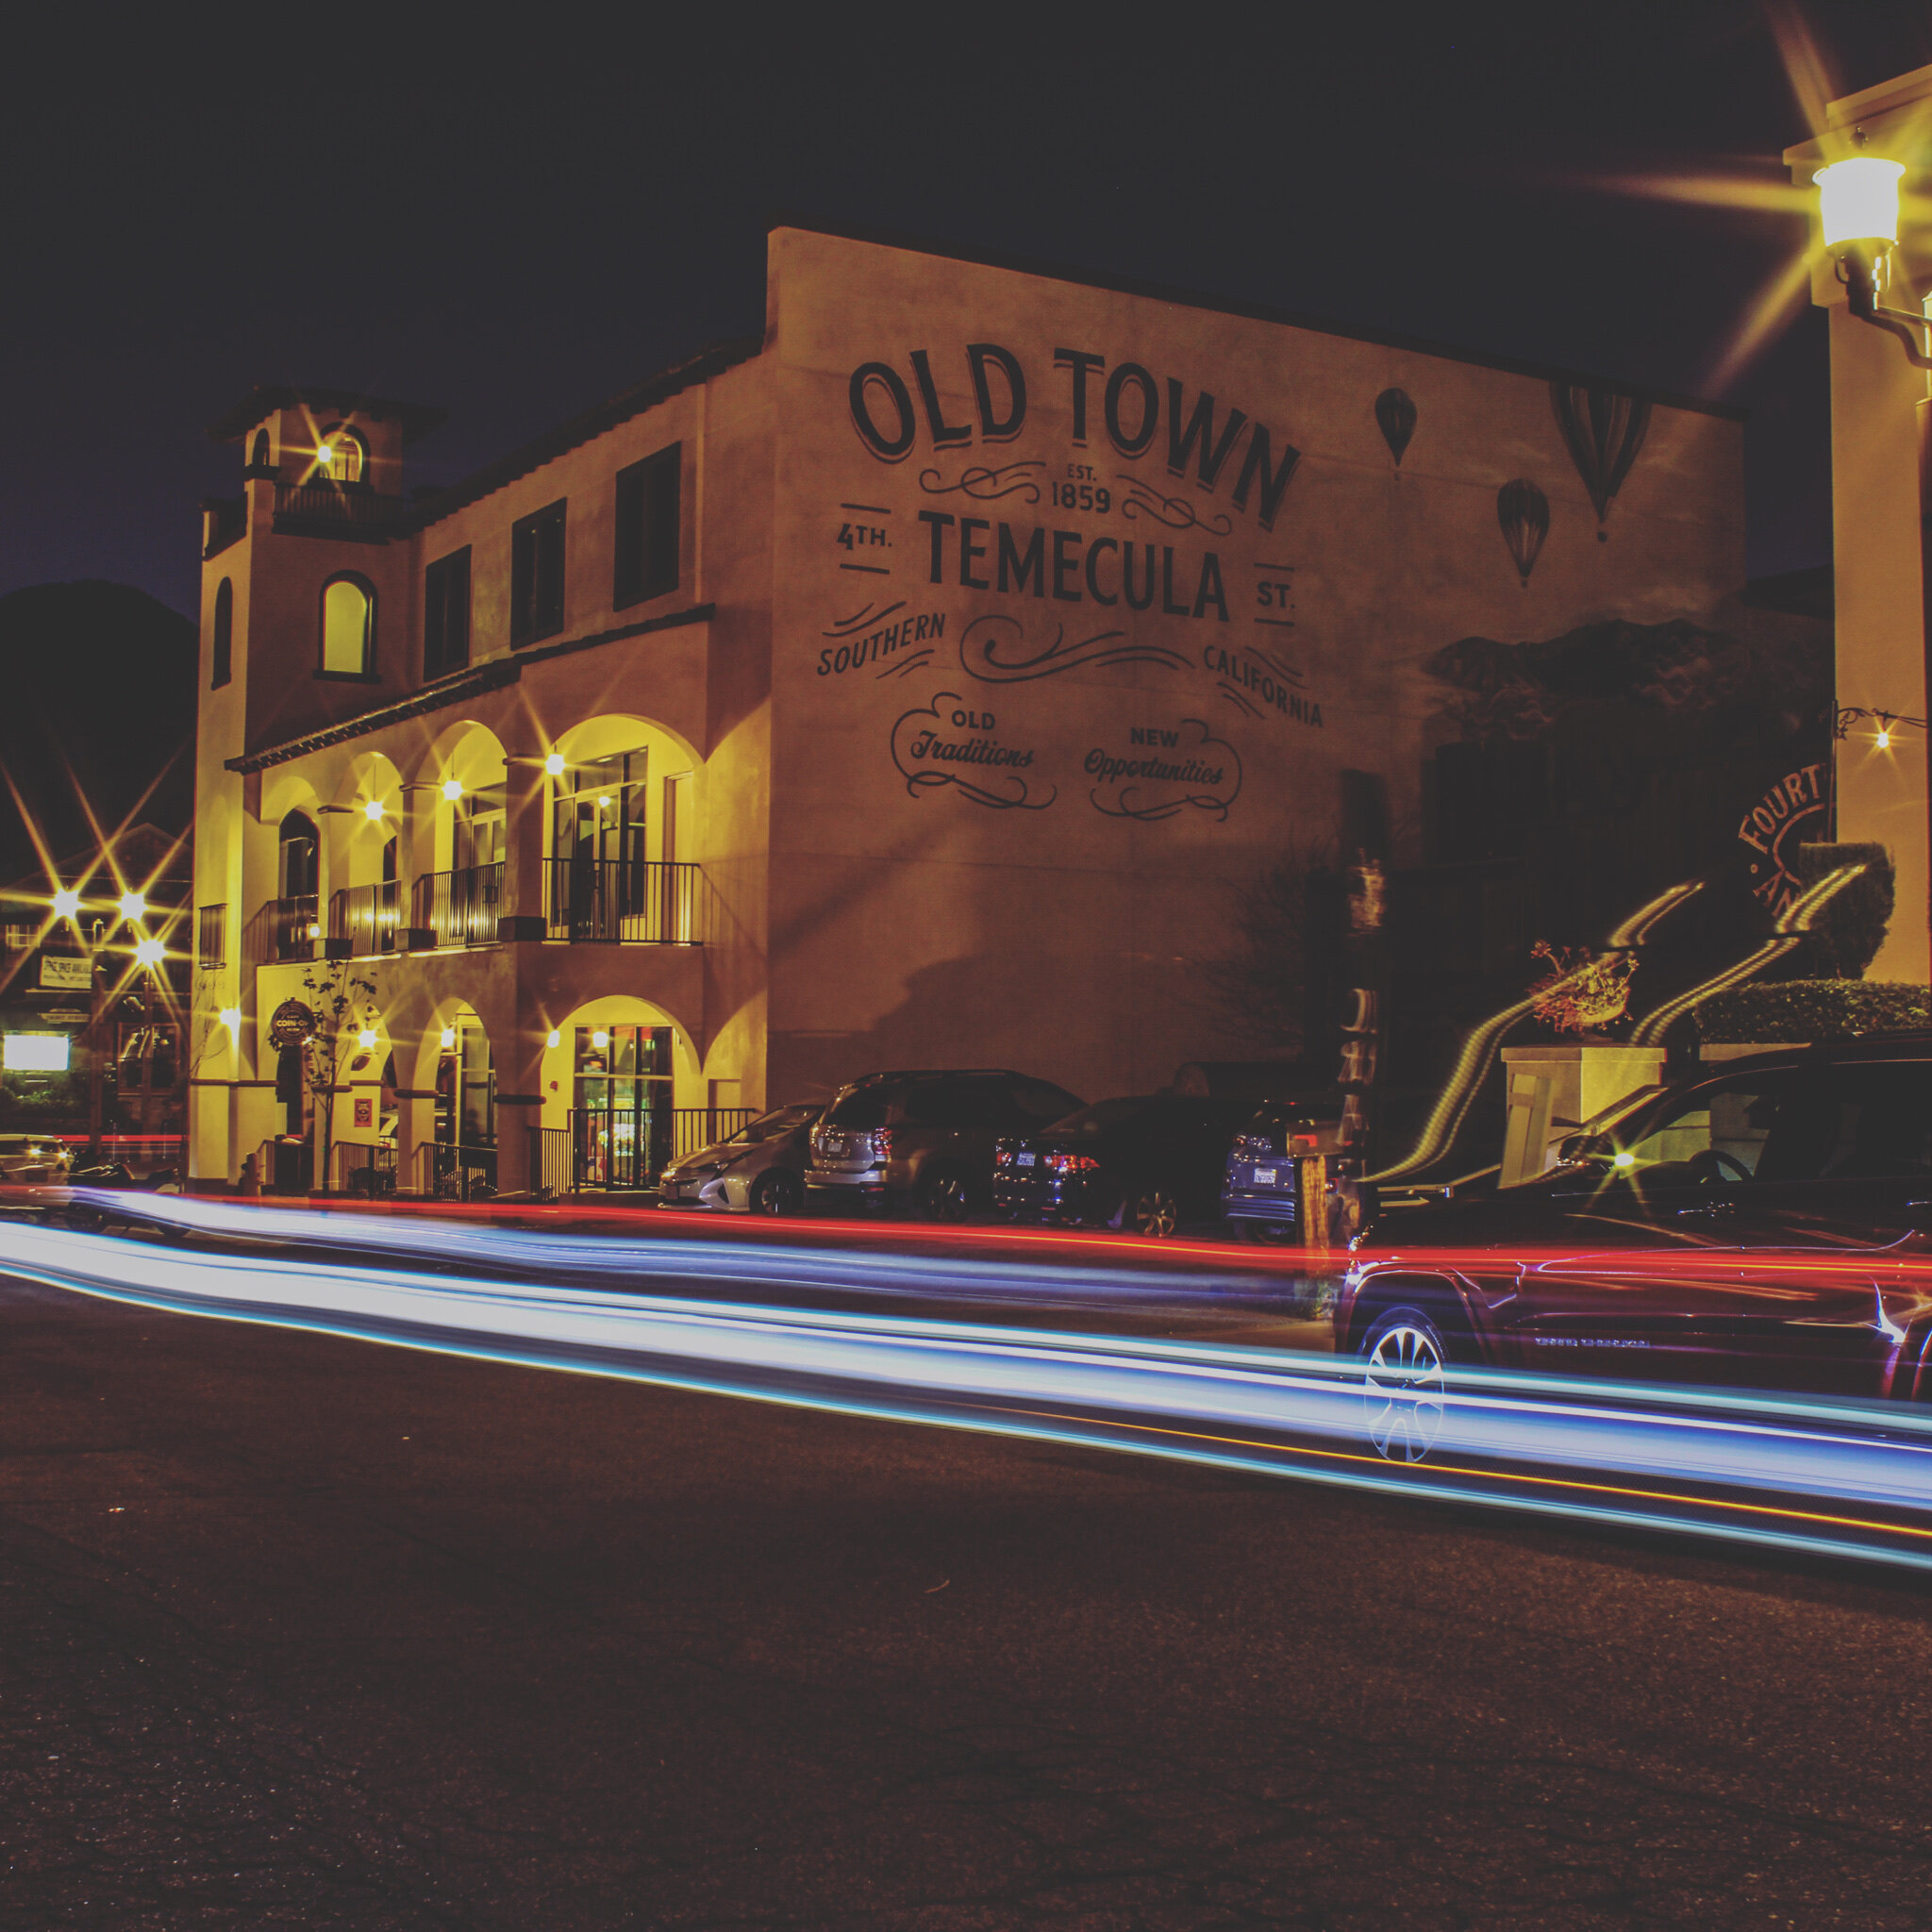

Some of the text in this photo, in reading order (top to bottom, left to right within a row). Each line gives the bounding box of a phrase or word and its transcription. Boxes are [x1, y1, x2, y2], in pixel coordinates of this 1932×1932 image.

[849, 343, 1301, 532] OLD TOWN
[1067, 463, 1096, 481] EST.
[1052, 481, 1110, 513] 1859
[837, 524, 892, 550] 4TH.
[918, 510, 1230, 623] TEMECULA
[1257, 581, 1296, 609] ST.
[817, 612, 946, 676] SOUTHERN
[1204, 645, 1324, 728] CALIFORNIA
[951, 710, 996, 730] OLD
[1131, 727, 1179, 748] NEW
[910, 730, 1034, 768] Traditions
[1085, 748, 1223, 785] Opportunities
[1739, 763, 1827, 855] FOURT
